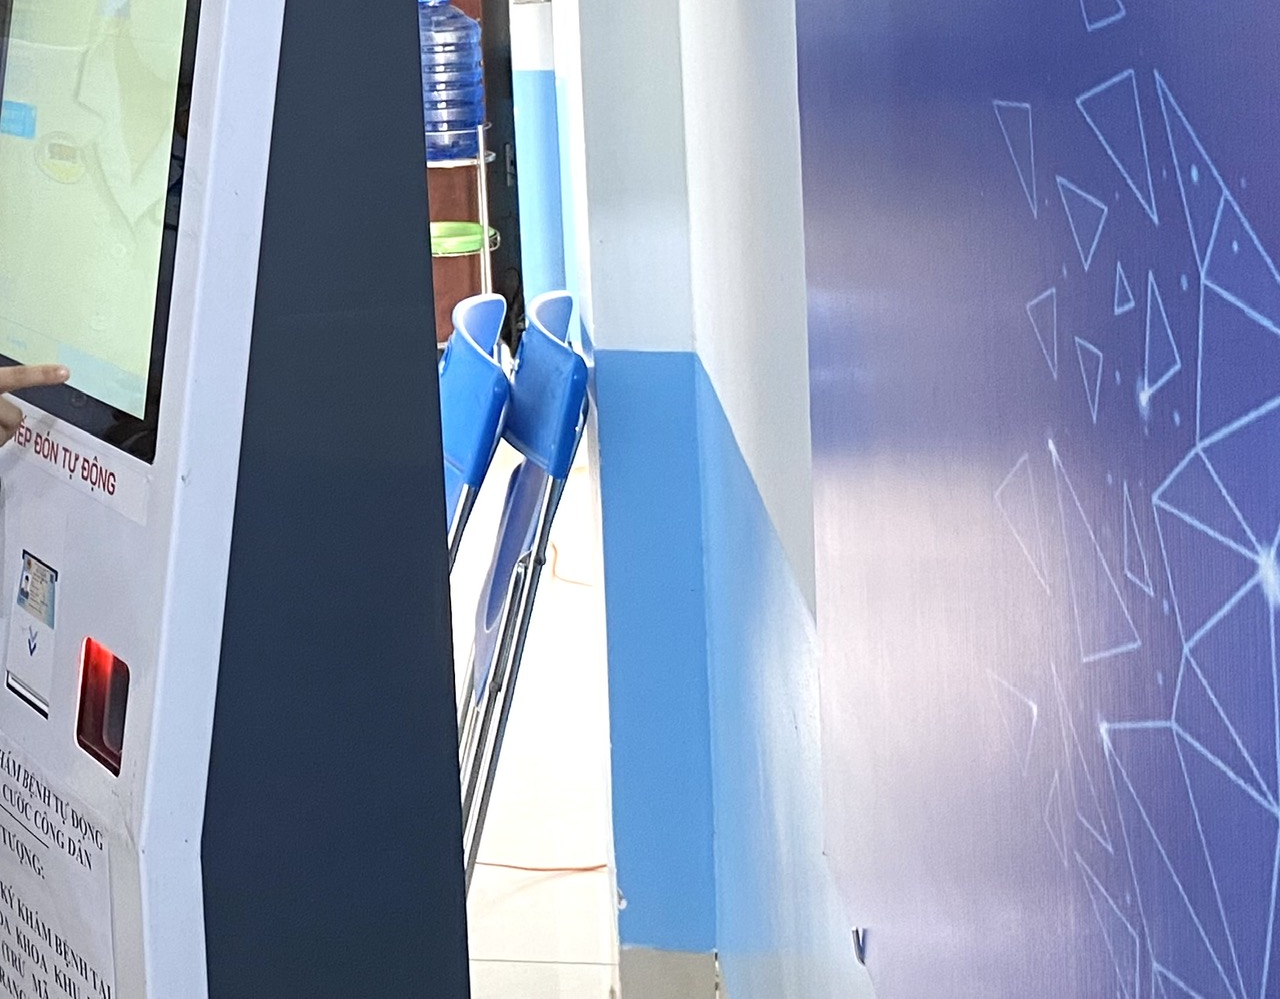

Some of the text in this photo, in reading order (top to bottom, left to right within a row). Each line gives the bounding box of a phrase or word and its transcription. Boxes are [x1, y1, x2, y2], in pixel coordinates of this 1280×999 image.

[34, 430, 60, 465] ĐÓN
[62, 446, 80, 481] TỰ
[81, 455, 117, 496] ĐỘNG
[22, 767, 51, 808] BỆNH
[52, 792, 70, 826] TỰ
[70, 807, 104, 851] ĐỘNG
[33, 809, 65, 850] CÔNG
[67, 836, 92, 872] DÂN
[15, 925, 49, 975] KHOA
[16, 897, 53, 949] KHÁM
[54, 932, 90, 983] BỆNH
